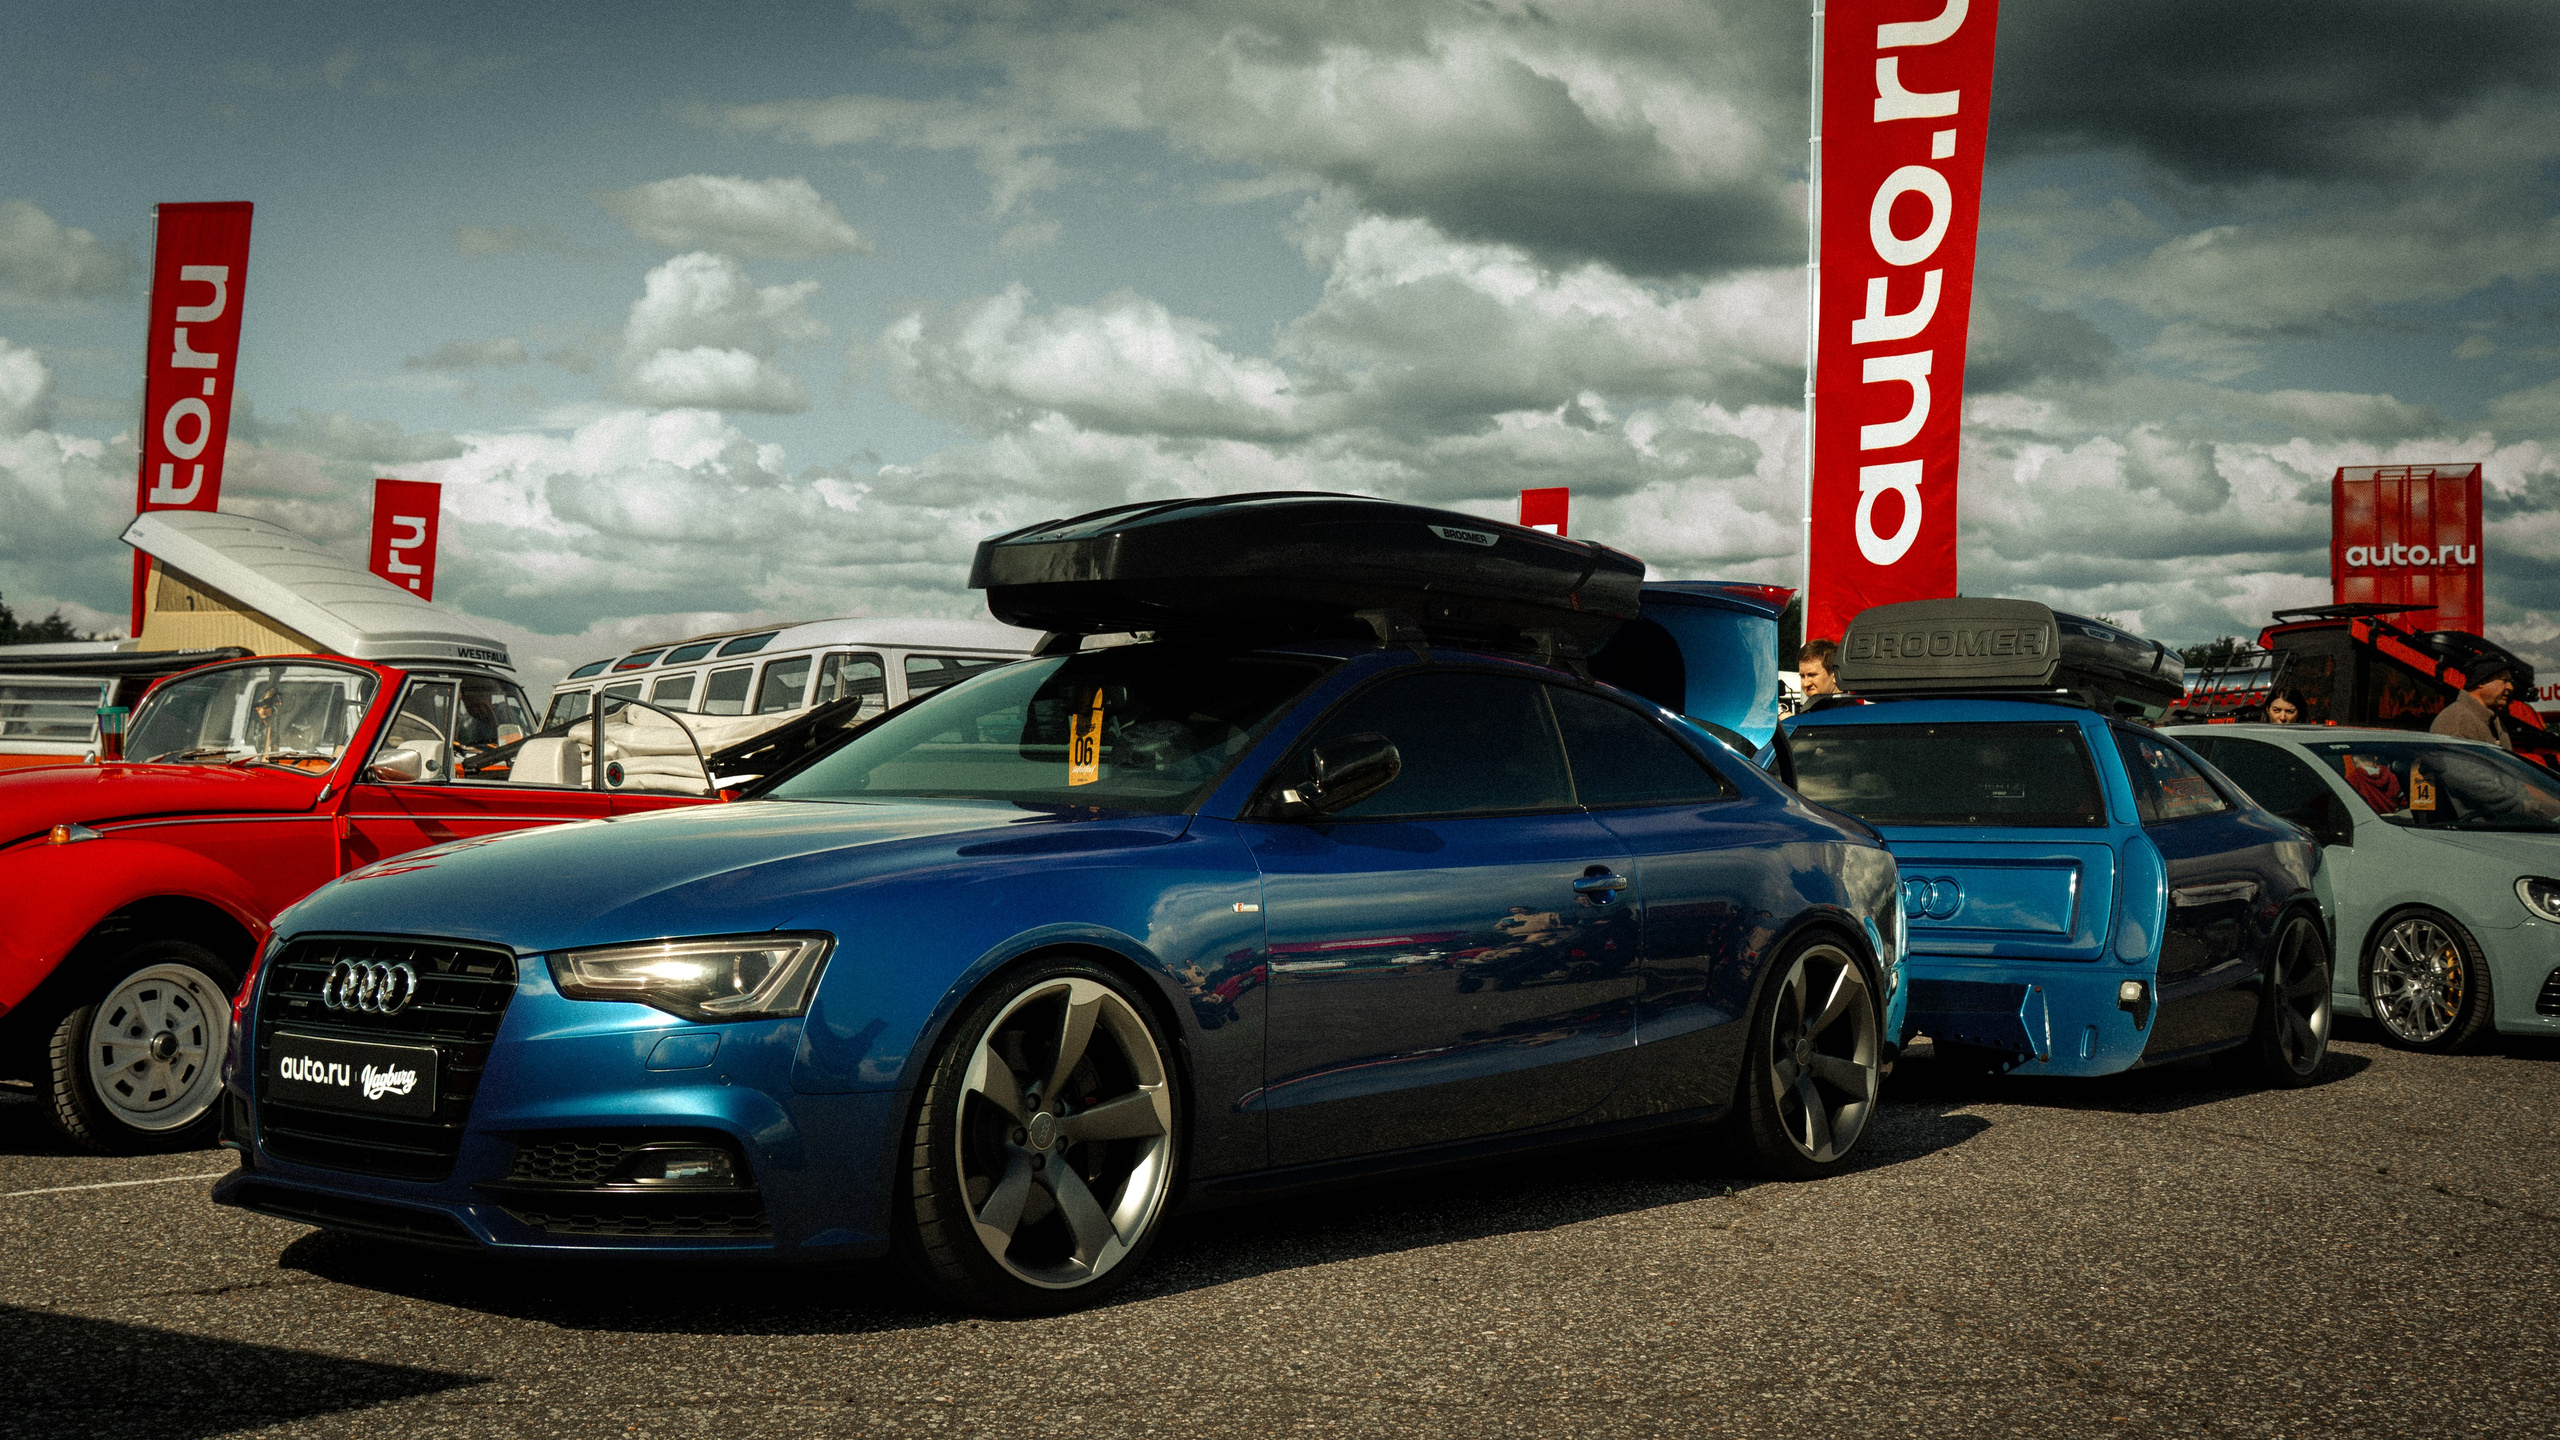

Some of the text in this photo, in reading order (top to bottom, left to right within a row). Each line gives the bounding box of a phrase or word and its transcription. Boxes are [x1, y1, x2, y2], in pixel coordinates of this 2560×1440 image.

[1442, 528, 1488, 544] BROOMER
[2345, 542, 2477, 567] auto.ru
[457, 647, 508, 664] WESTFALIA
[1850, 628, 2044, 660] BROOMER
[1075, 736, 1094, 767] 06
[2417, 785, 2430, 800] 14
[281, 1055, 418, 1100] auto.ru Vagburg
